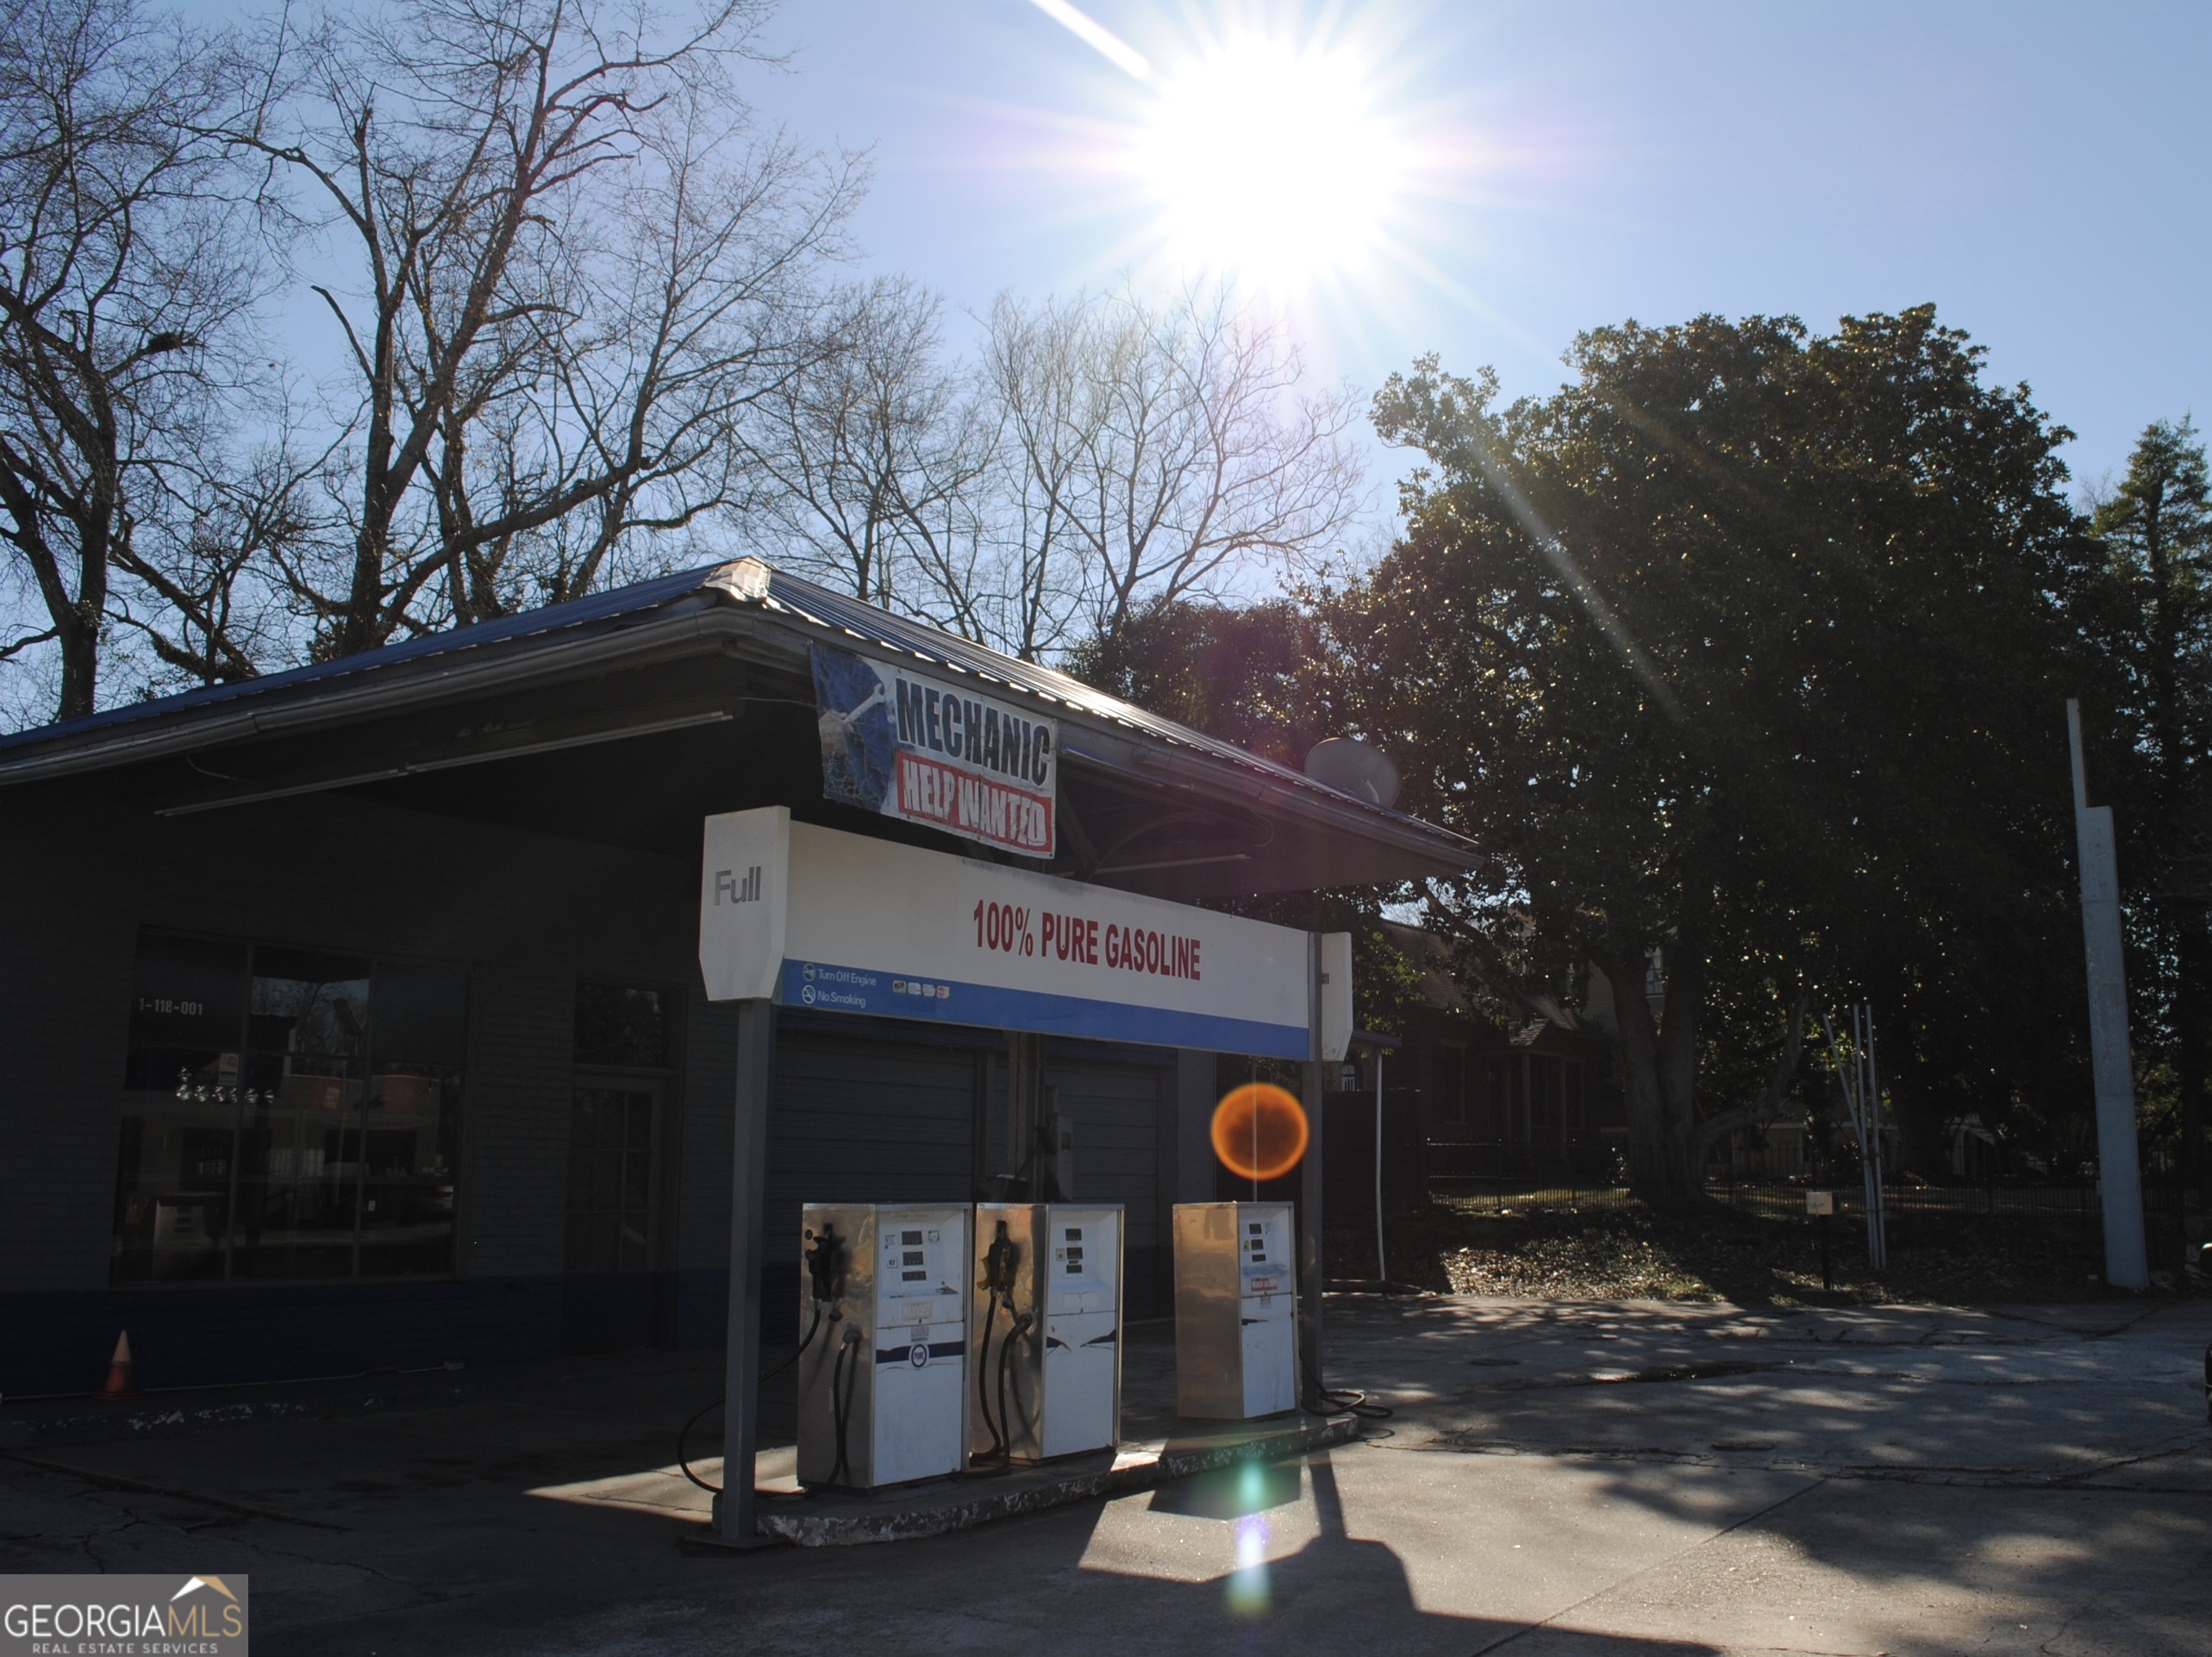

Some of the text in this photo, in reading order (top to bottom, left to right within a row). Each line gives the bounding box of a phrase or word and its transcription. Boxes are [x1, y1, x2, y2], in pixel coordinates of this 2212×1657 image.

[896, 678, 1051, 786] MECHANIC
[903, 759, 1047, 847] HELP WANTED
[715, 866, 761, 906] Full
[973, 899, 1201, 980] 100% PURE GASOLINE
[817, 968, 877, 986] Turn Off Engine
[139, 997, 203, 1016] 1-118-001
[817, 991, 866, 1009] No Smoking
